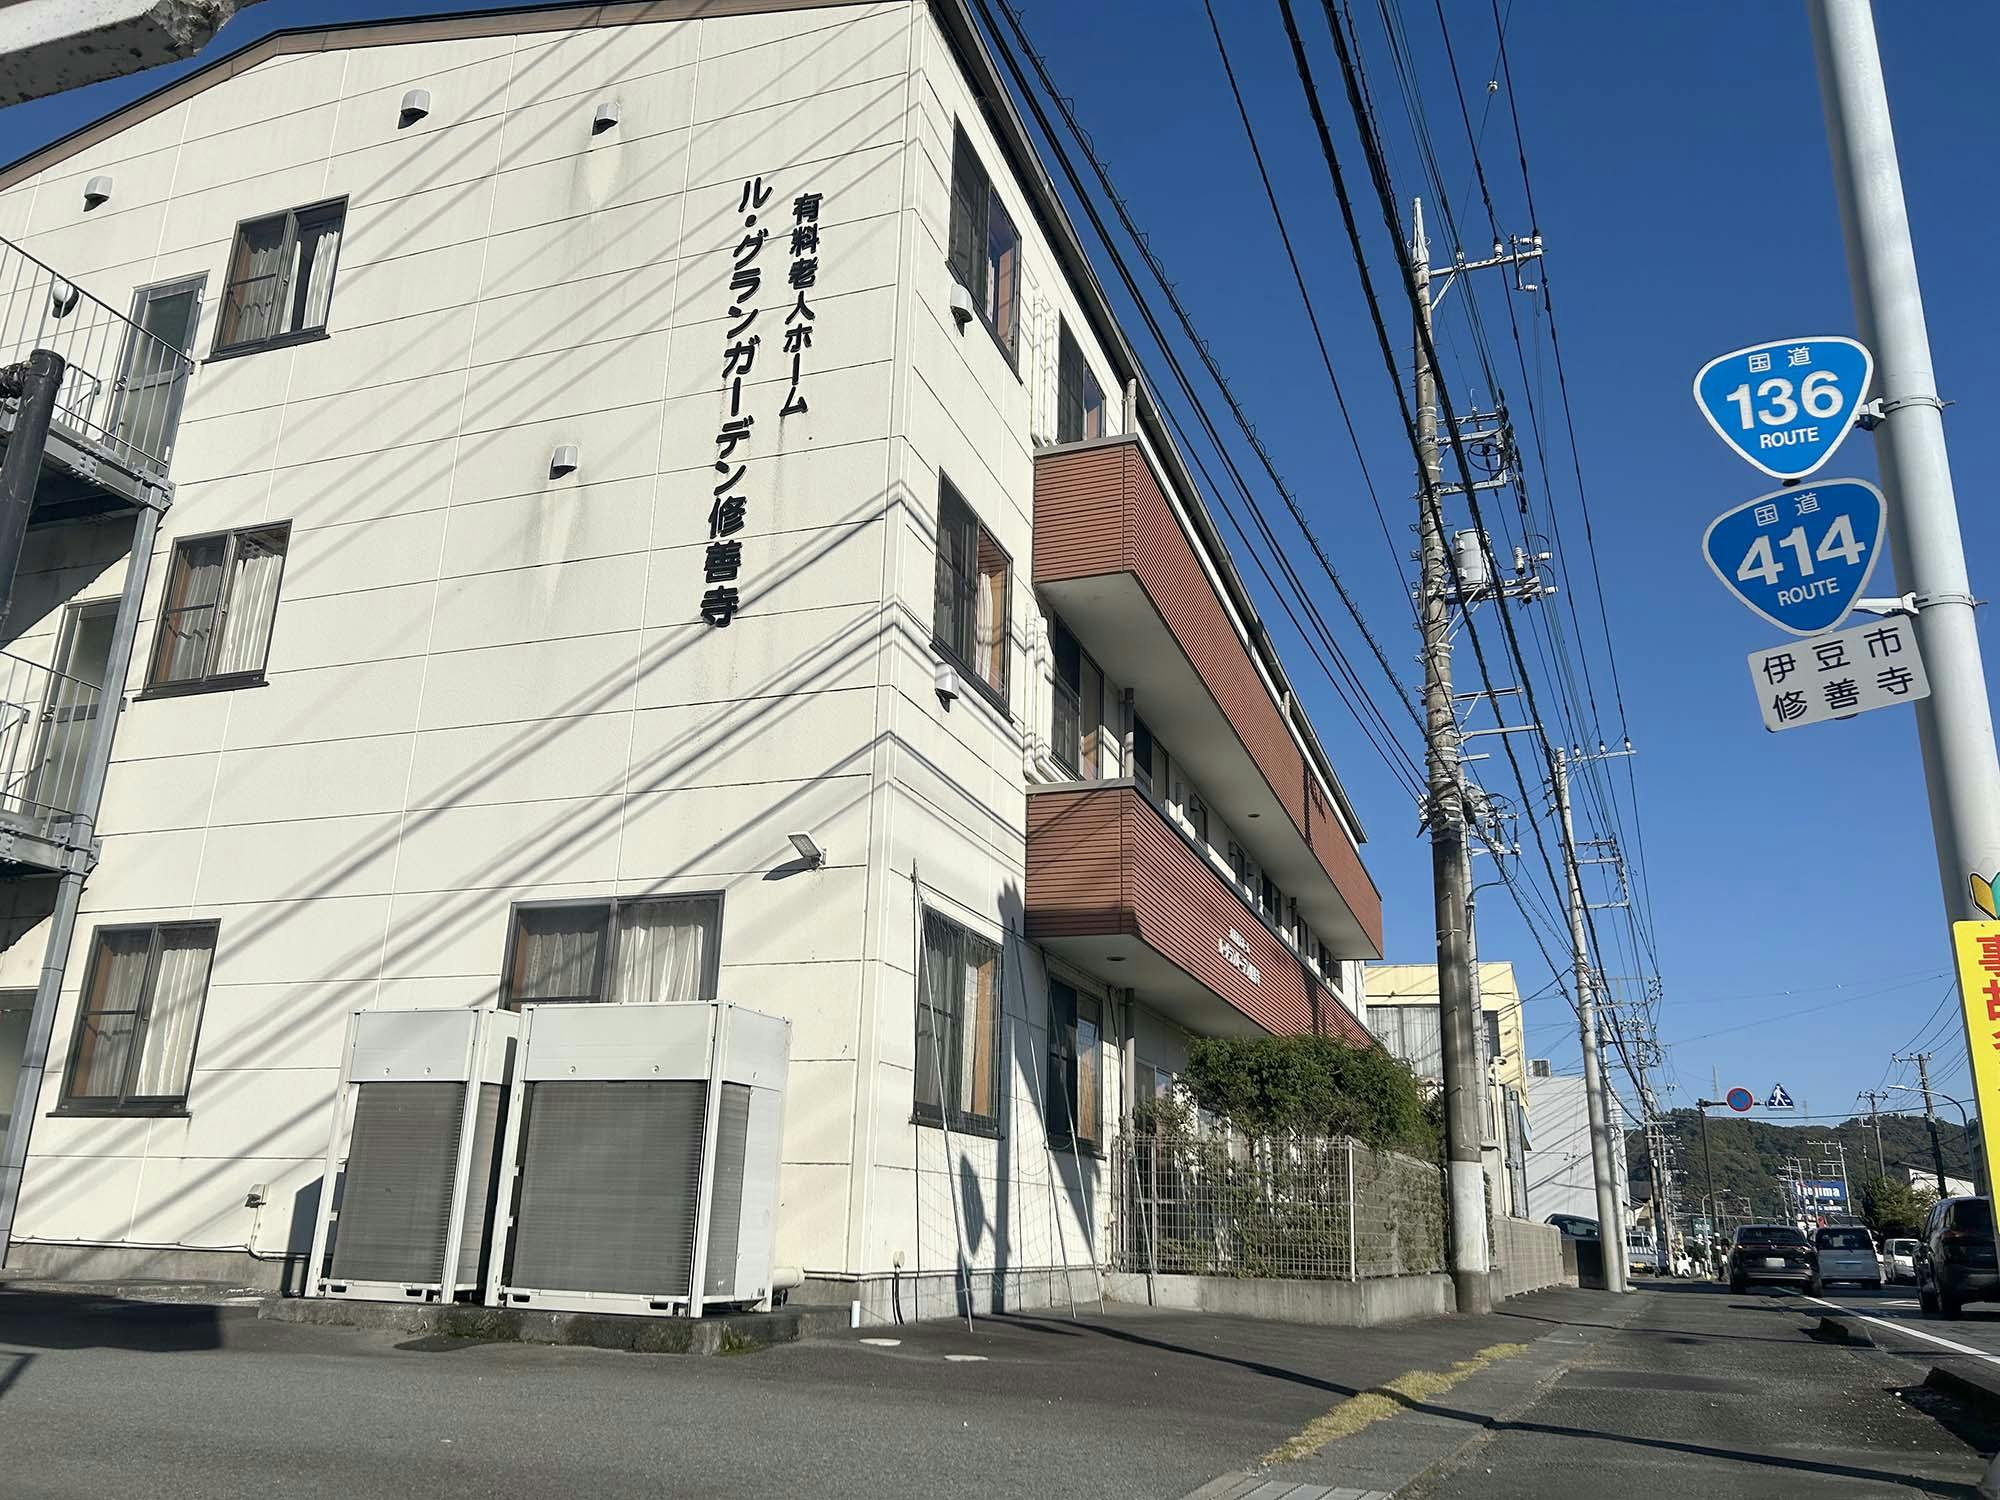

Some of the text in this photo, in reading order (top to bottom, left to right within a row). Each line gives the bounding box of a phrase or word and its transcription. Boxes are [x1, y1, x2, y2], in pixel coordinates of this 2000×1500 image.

[779, 193, 823, 418] 有料老人ホーム
[1748, 347, 1812, 372] 国道
[700, 177, 773, 629] ル・グランガーデン修善寺
[1726, 370, 1843, 430] 136
[1760, 427, 1819, 449] ROUTE
[1755, 493, 1820, 527] 国道
[1736, 514, 1865, 586] 414
[1778, 577, 1840, 606] ROUTE
[1762, 626, 1901, 685] 伊豆市
[1772, 666, 1914, 722] 修善寺
